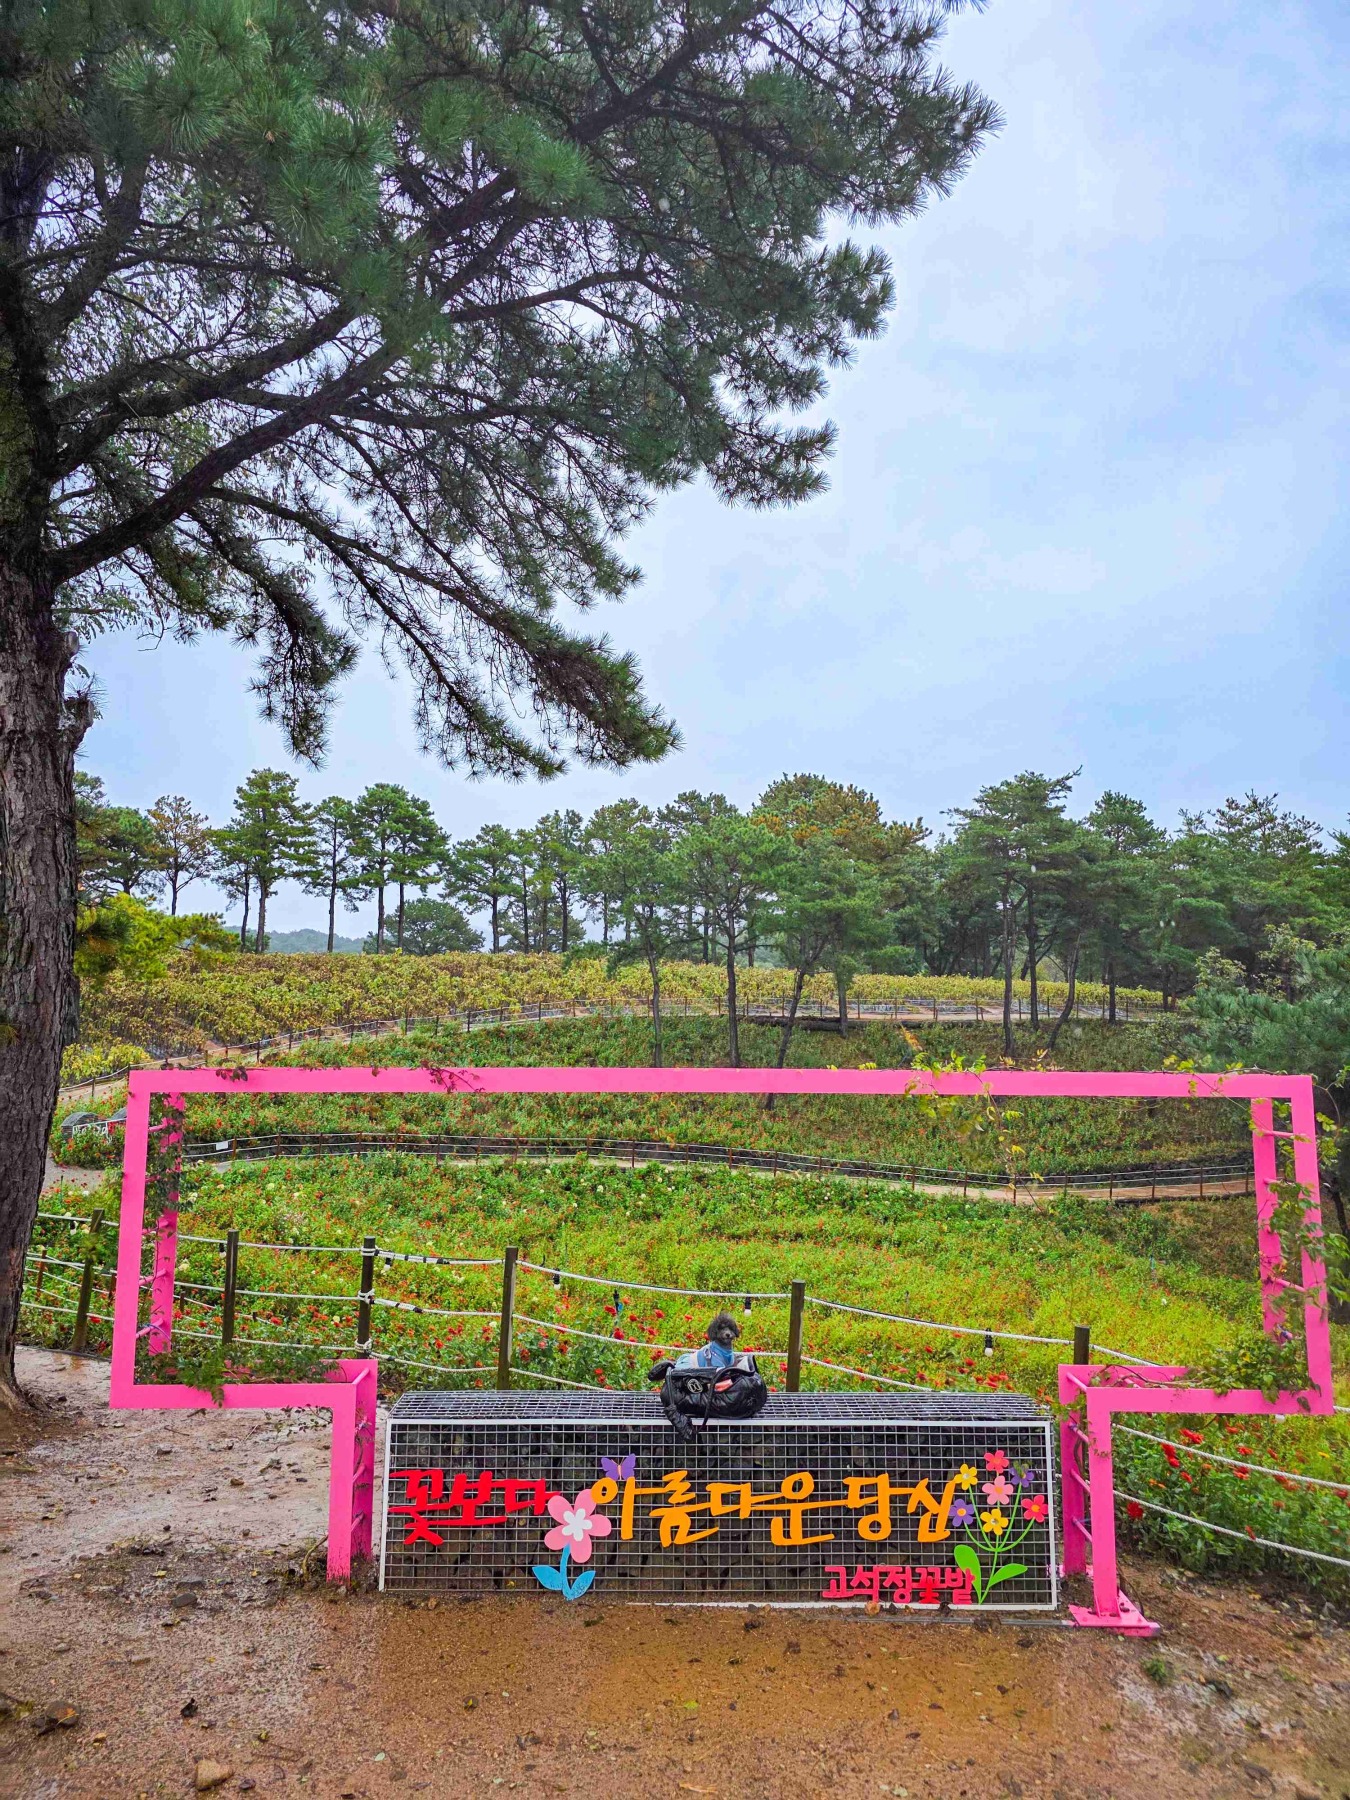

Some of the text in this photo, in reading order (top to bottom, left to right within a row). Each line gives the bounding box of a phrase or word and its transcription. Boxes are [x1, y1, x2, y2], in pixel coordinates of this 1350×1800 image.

[388, 1469, 958, 1548] 꽃보다 아름다운 당신
